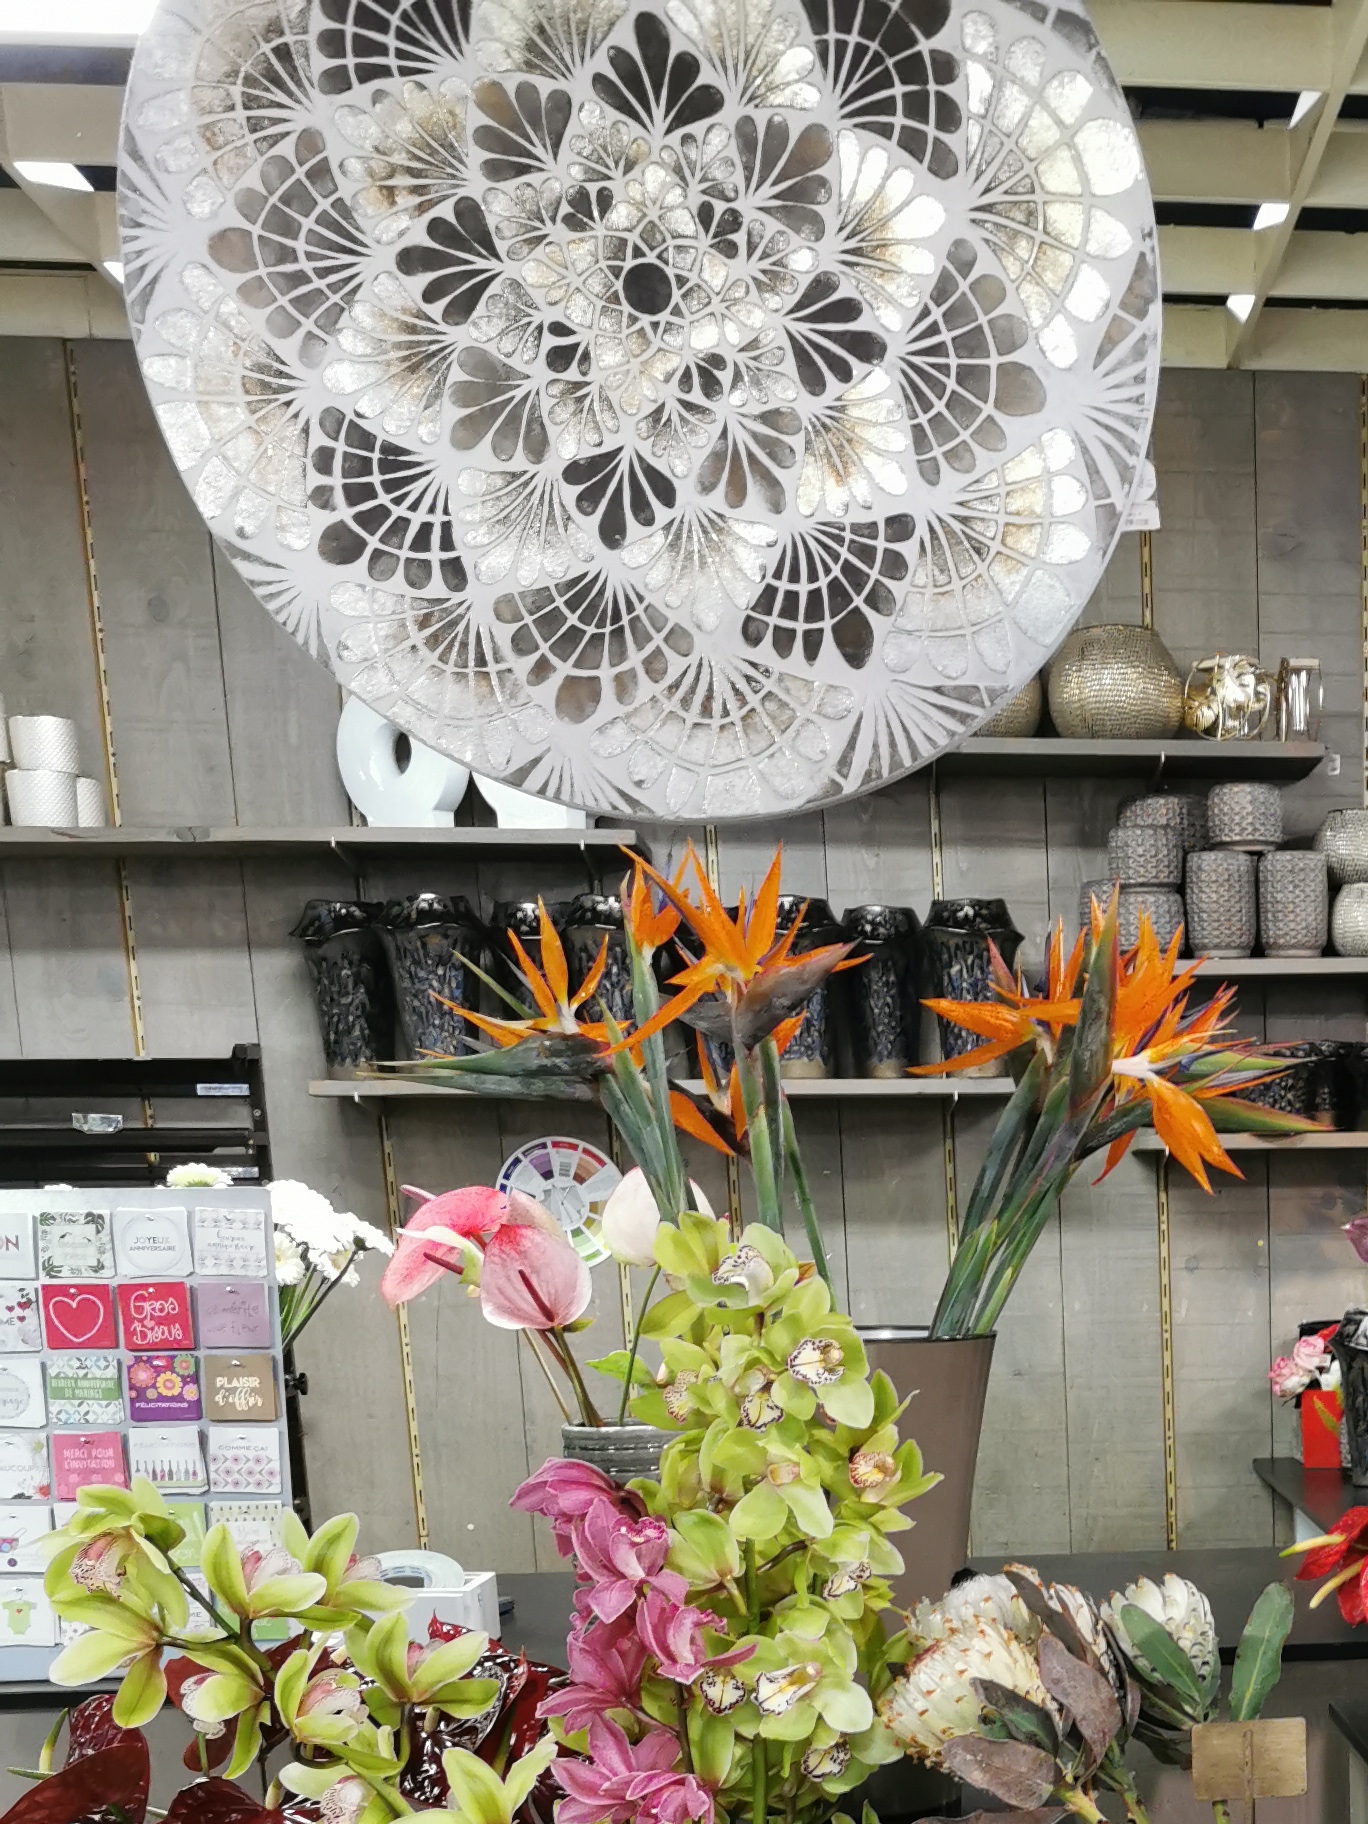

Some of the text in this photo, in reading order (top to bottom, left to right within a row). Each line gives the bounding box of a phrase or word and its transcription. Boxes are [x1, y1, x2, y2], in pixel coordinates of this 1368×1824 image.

[133, 1236, 170, 1245] JOYEUX
[216, 1376, 260, 1388] PLAISIR
[74, 1388, 103, 1399] MARIAGE
[63, 1447, 115, 1459] MERCI POUR
[218, 1444, 251, 1452] COMME
